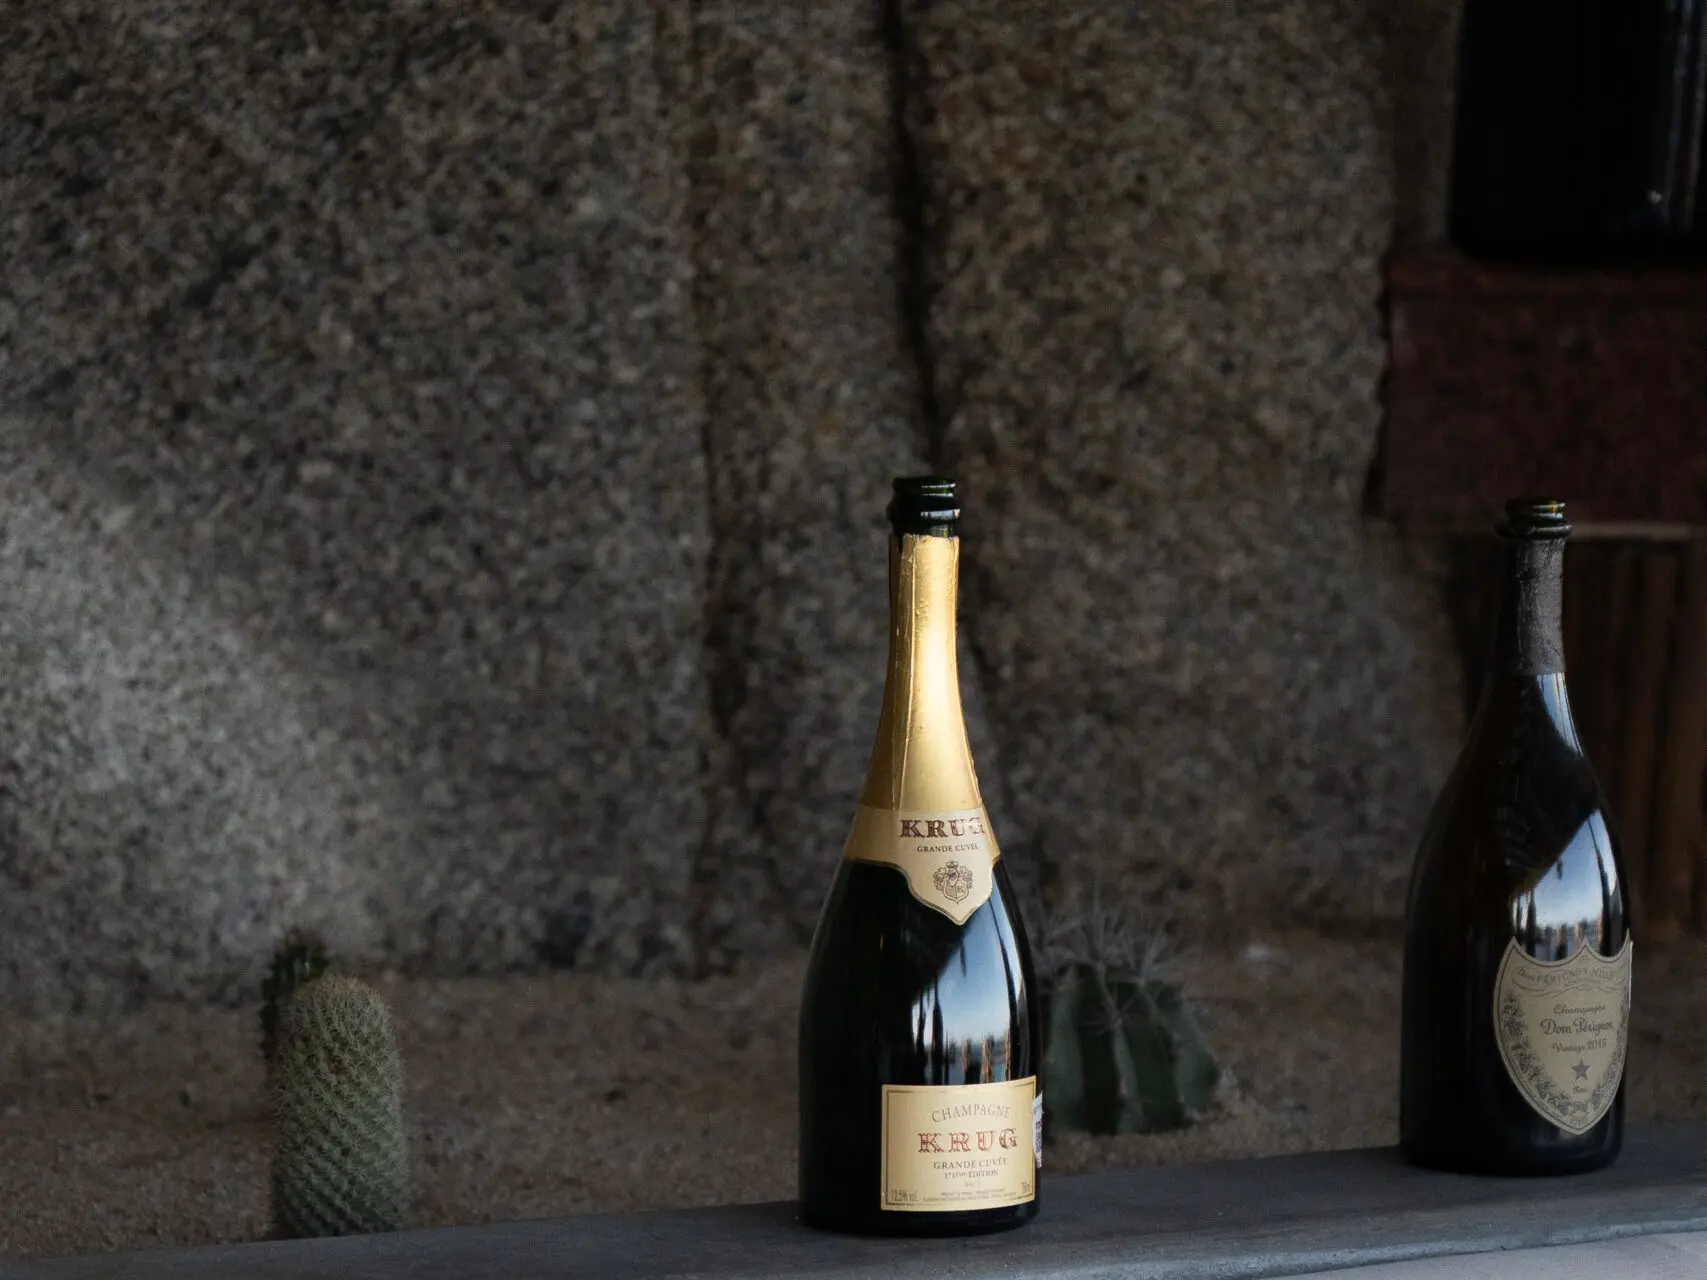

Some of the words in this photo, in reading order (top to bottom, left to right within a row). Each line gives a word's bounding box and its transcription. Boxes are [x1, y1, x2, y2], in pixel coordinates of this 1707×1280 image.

[900, 817, 986, 838] KRUG
[917, 845, 953, 853] GRANDE
[1541, 1018, 1572, 1034] Dom
[931, 1103, 1012, 1122] CHAMPAGNE
[917, 1127, 1018, 1153] KRUG
[933, 1160, 977, 1169] GRANDE
